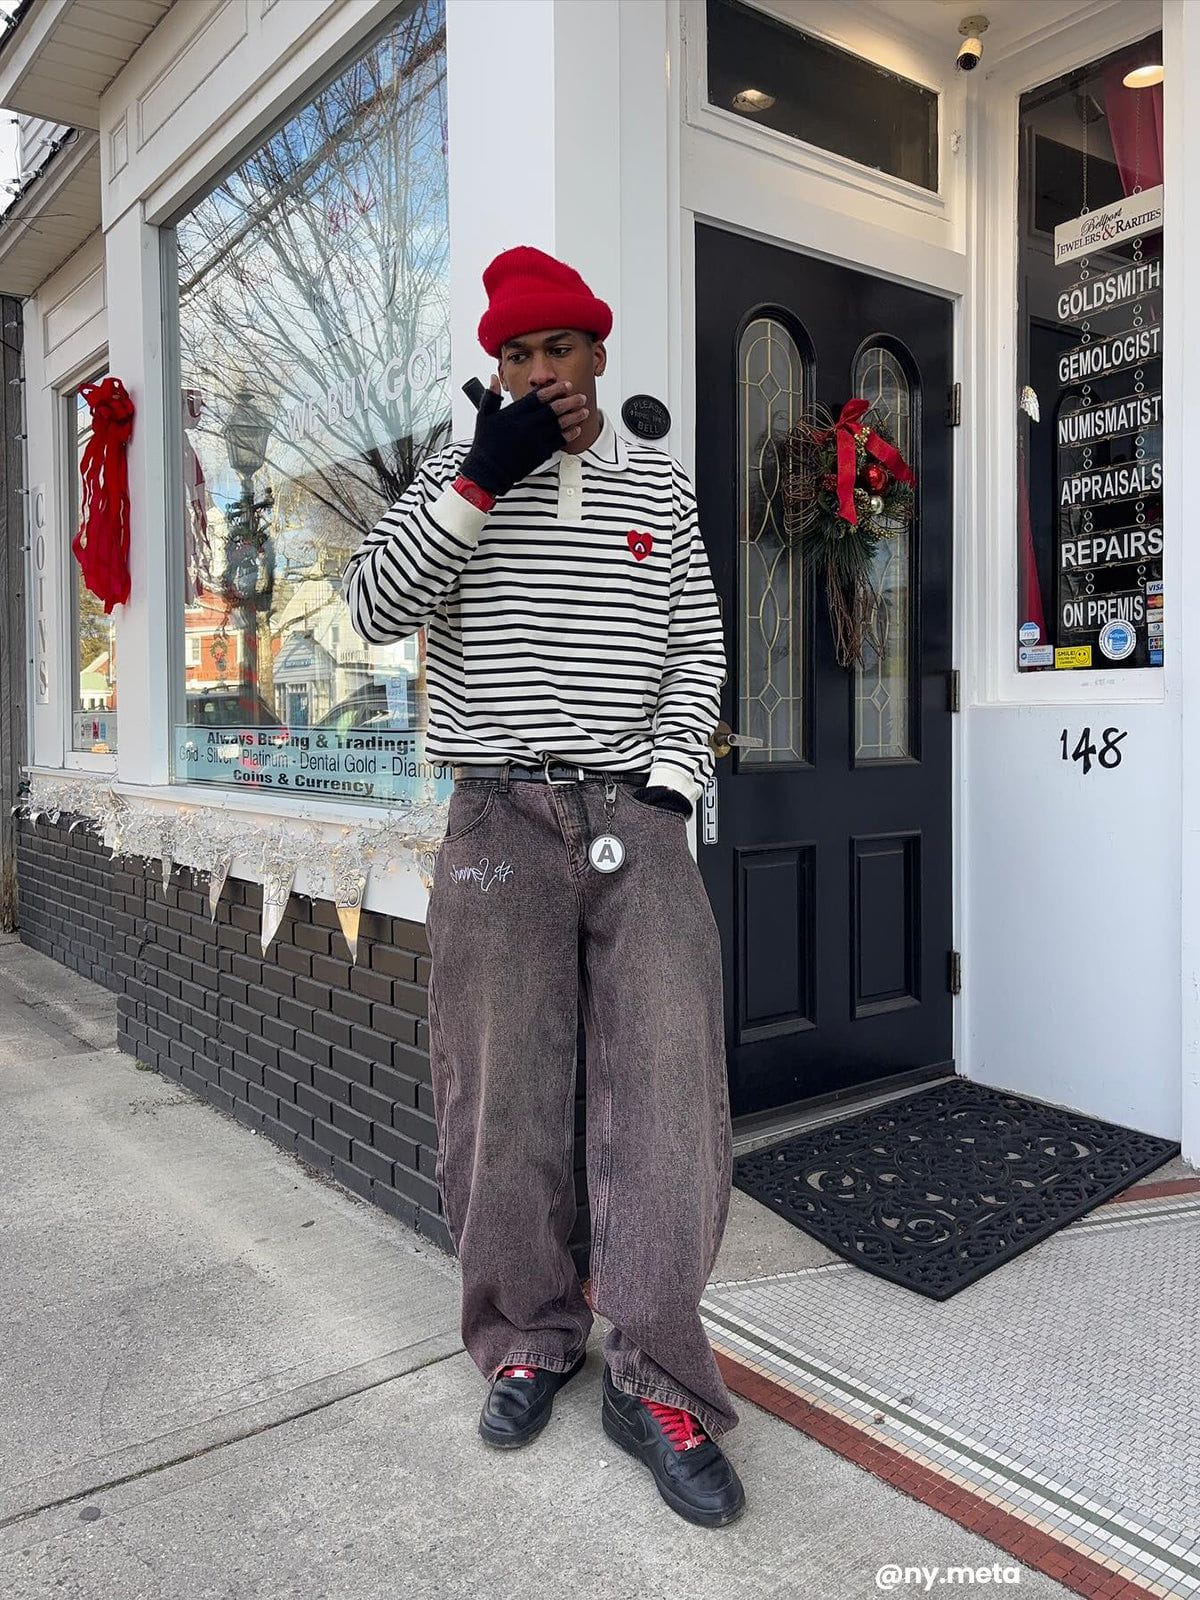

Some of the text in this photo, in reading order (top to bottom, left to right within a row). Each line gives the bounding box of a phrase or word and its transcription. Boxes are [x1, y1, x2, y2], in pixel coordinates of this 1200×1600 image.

[1080, 207, 1123, 236] Bellport
[1102, 224, 1117, 241] &
[1057, 261, 1161, 320] GOLDSMITH
[1058, 327, 1161, 383] GEMOLOGIST
[327, 371, 373, 426] BUY
[384, 338, 451, 401] GOL
[638, 421, 659, 433] BELL
[1058, 395, 1162, 445] NUMISMATIST
[1060, 462, 1162, 506] APPRAISALS
[1061, 528, 1163, 568] REPAIRS
[35, 492, 48, 697] COINS
[1063, 595, 1144, 628] ON PREMIS
[207, 731, 416, 754] Always Buying & Trading:
[1060, 727, 1128, 775] 148
[233, 769, 375, 796] Coins & Currency
[242, 749, 289, 768] Platinum
[300, 752, 340, 773] Dental
[344, 754, 377, 774] Gold
[392, 759, 453, 781] Diamon
[706, 780, 715, 841] PULL
